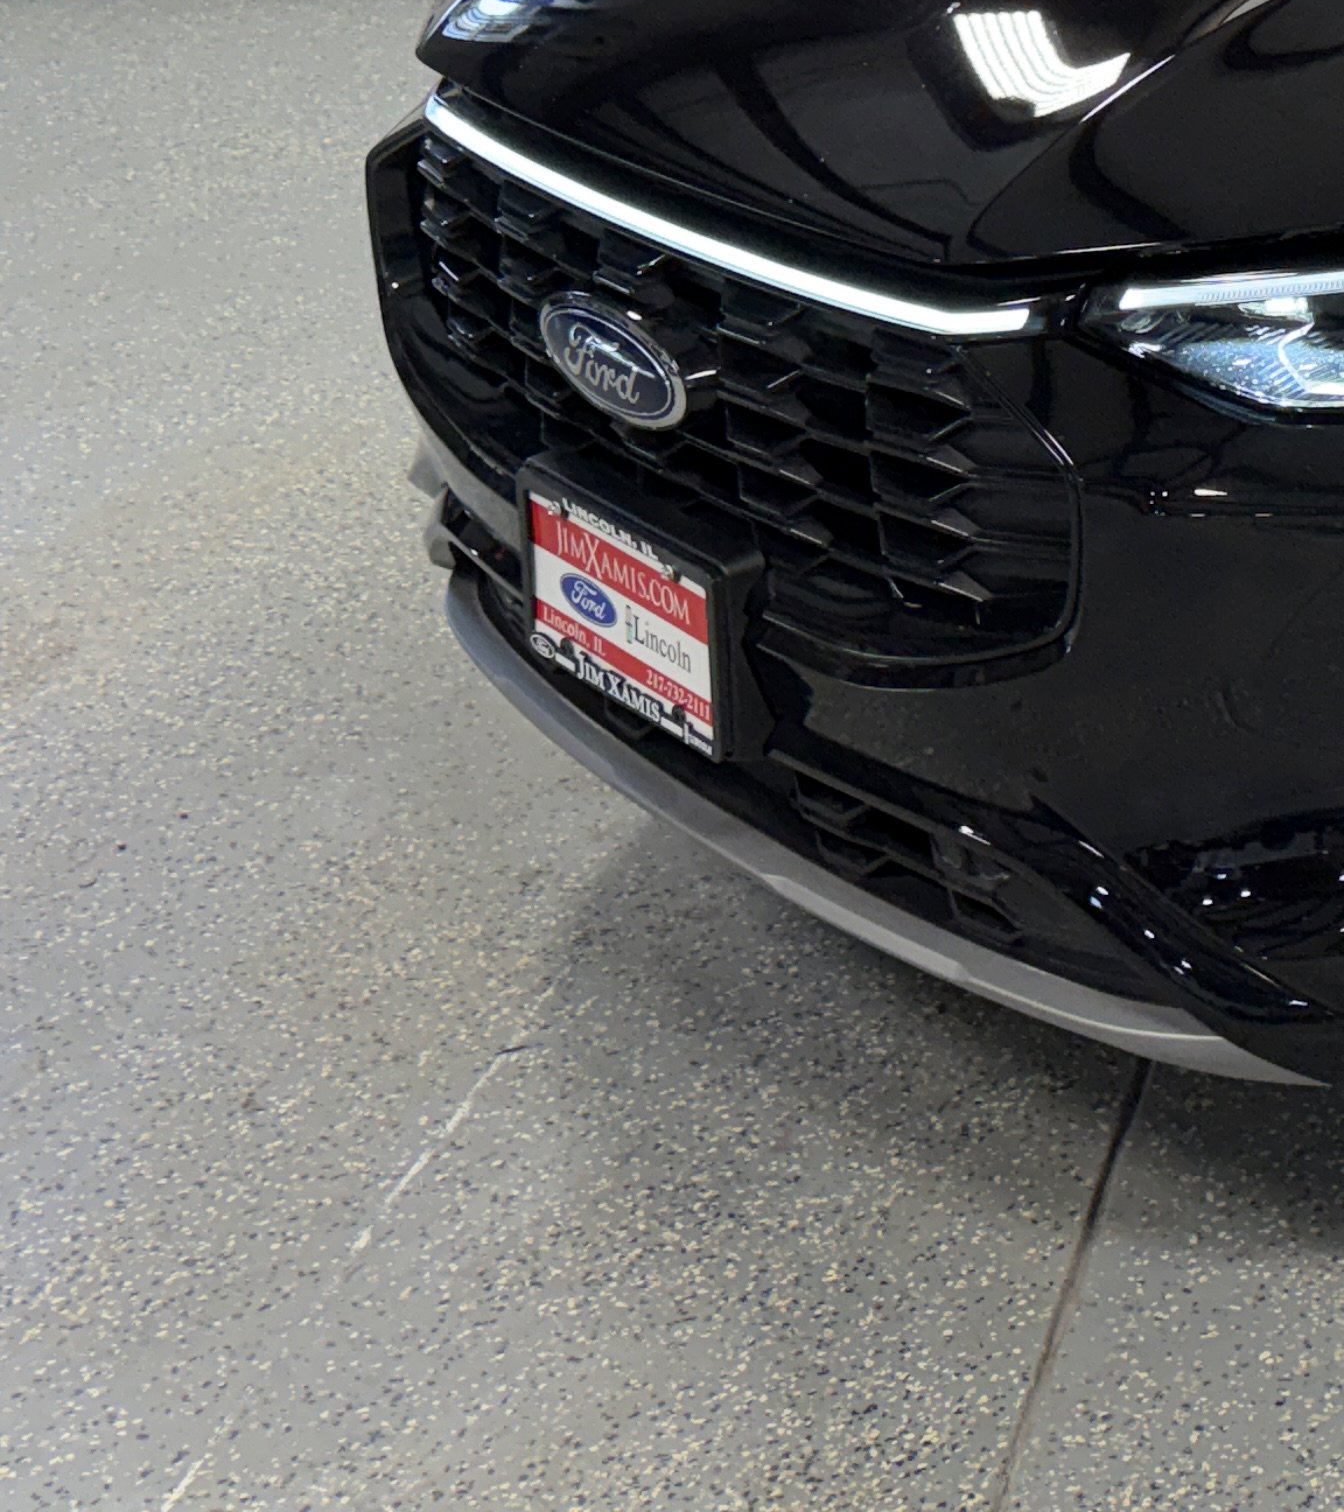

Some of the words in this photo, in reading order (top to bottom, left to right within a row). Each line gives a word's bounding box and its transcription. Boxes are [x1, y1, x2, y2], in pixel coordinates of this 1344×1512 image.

[564, 322, 640, 404] Ford
[571, 580, 606, 621] Ford
[632, 614, 692, 674] Lincoln
[576, 651, 604, 691] JIM
[602, 668, 661, 724] XAMIS
